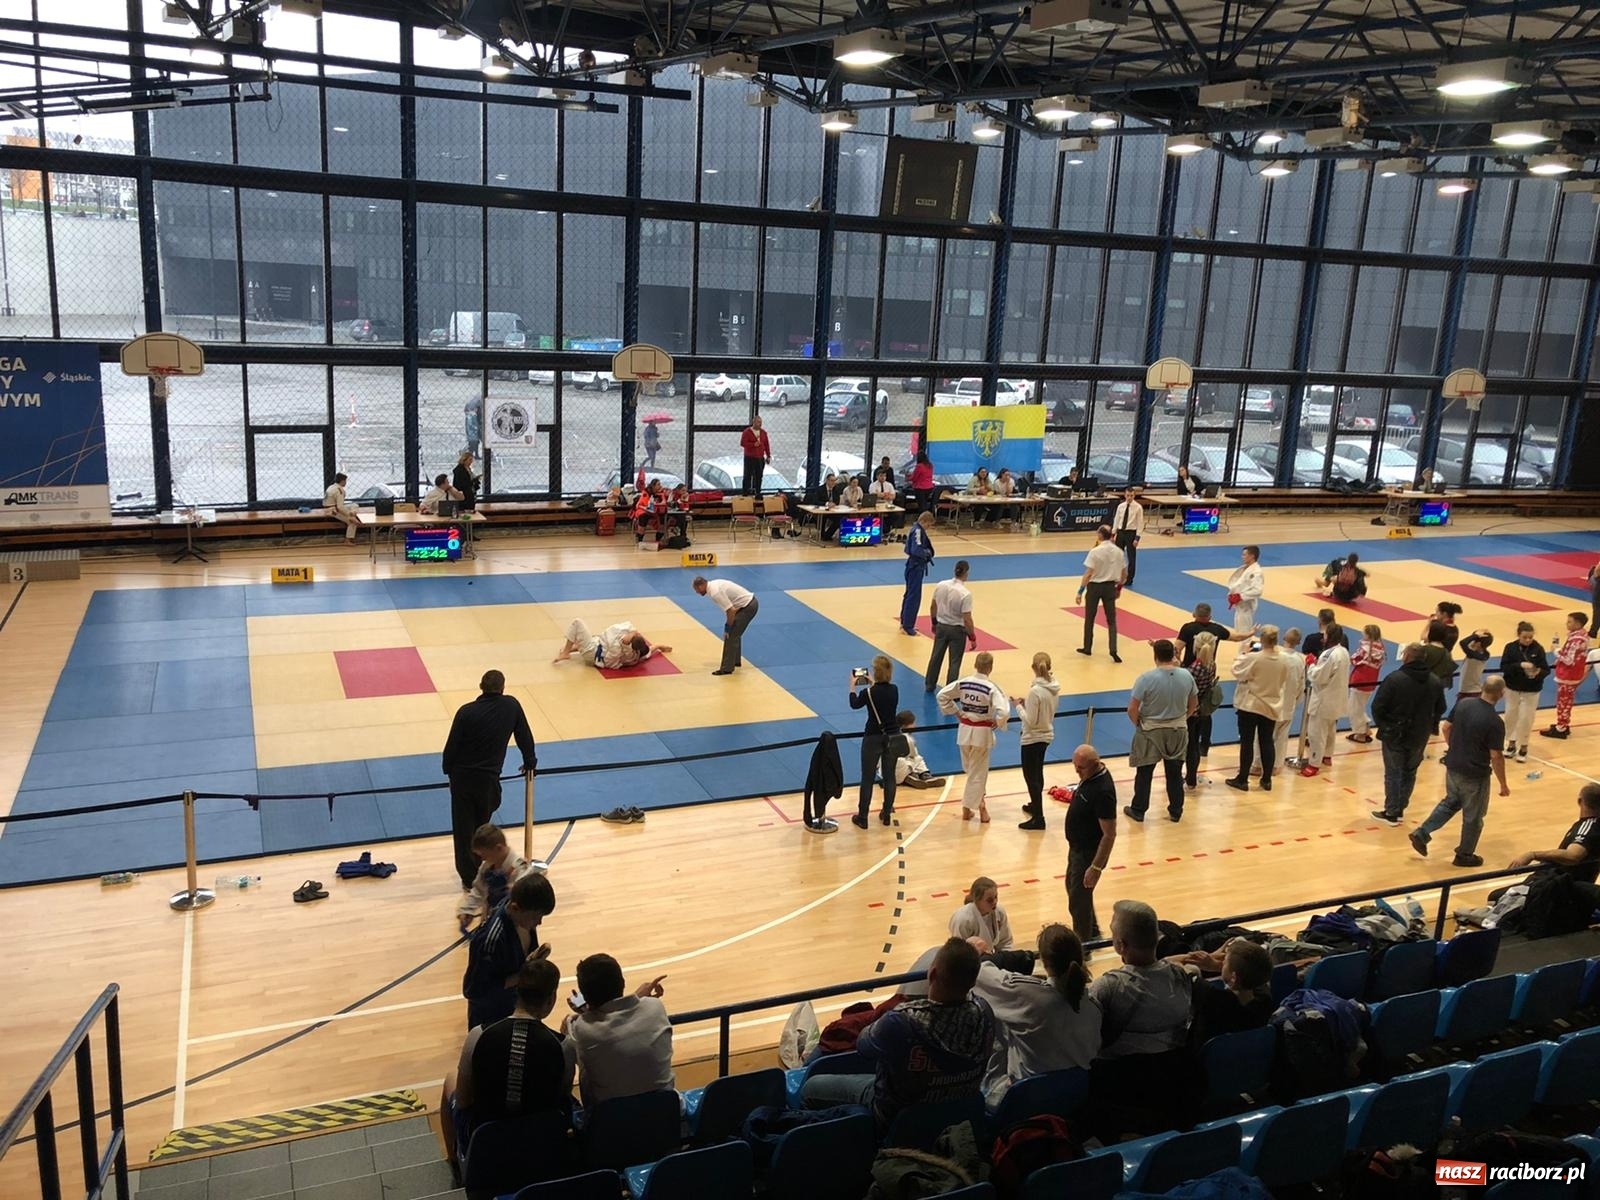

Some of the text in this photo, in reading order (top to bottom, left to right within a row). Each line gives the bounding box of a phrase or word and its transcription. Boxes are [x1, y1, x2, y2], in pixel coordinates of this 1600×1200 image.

[732, 315, 739, 324] B
[835, 322, 841, 331] B
[448, 529, 459, 539] 2
[448, 539, 459, 550] 0
[707, 553, 714, 564] 2
[13, 567, 24, 581] 3
[277, 567, 308, 580] MATA 1
[964, 693, 981, 702] POL
